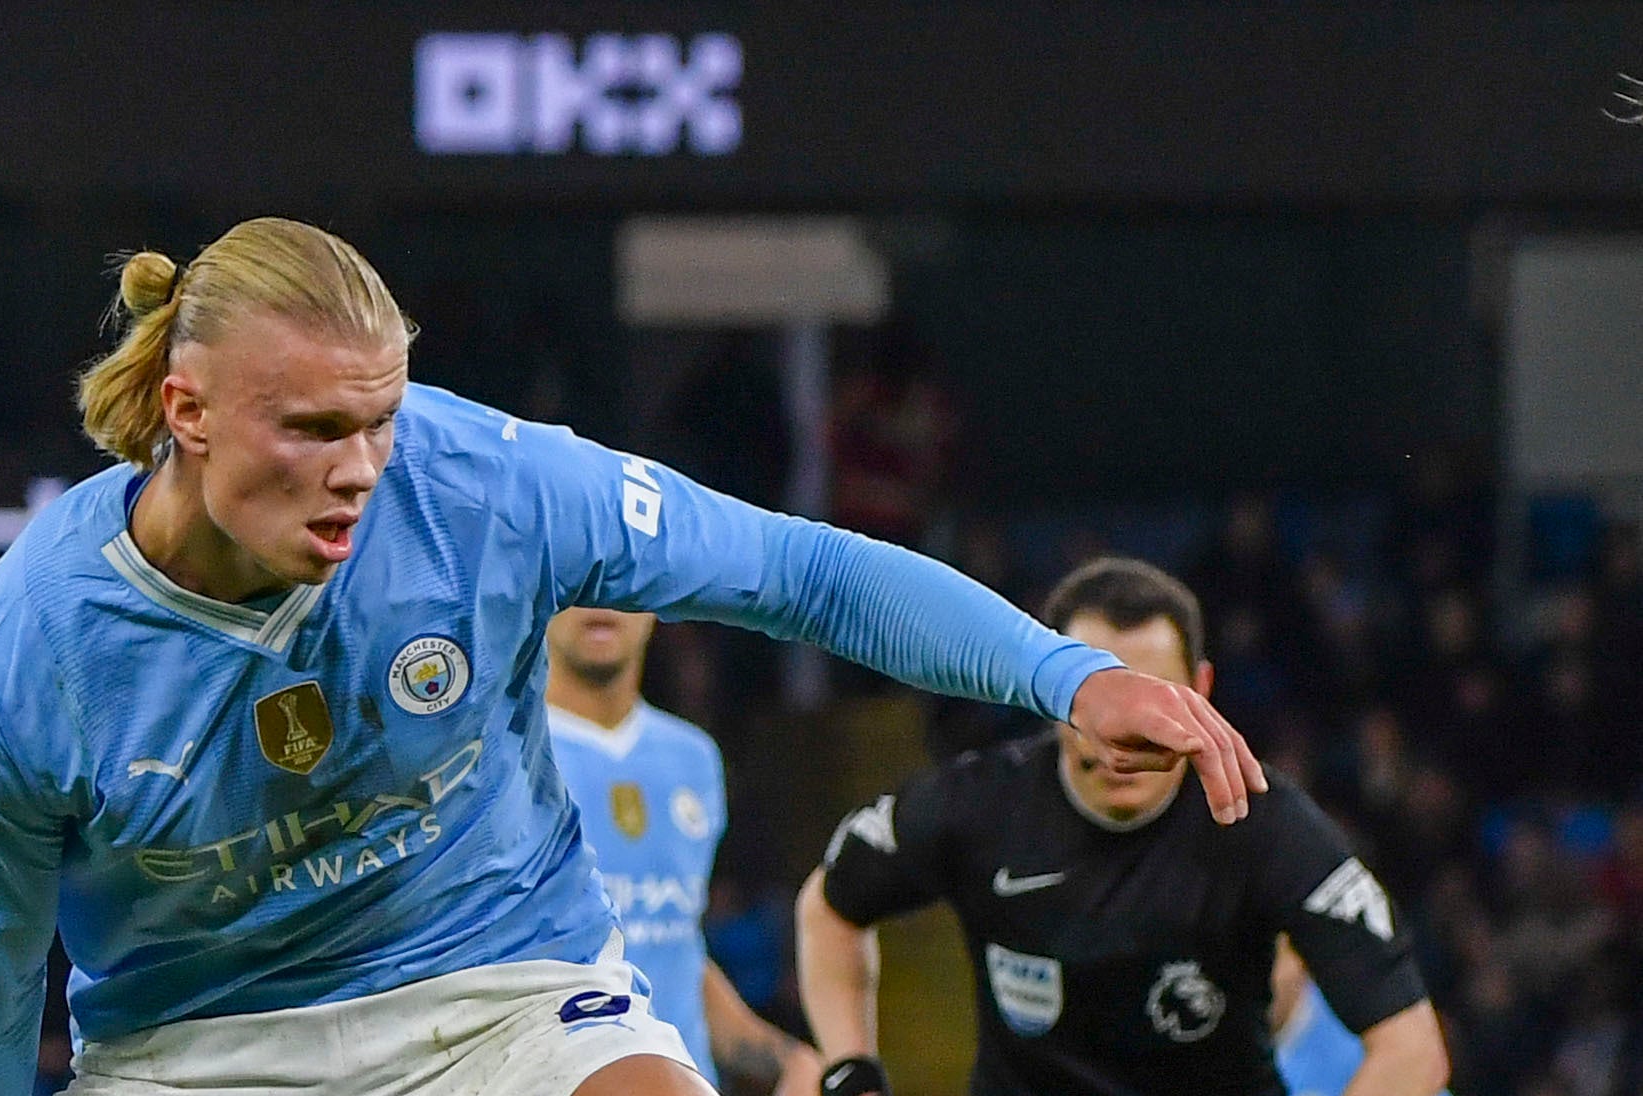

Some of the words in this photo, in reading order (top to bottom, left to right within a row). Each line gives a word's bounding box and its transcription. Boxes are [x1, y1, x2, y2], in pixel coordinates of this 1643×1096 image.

[414, 32, 744, 156] OKX
[621, 455, 662, 538] OK
[392, 641, 456, 679] MANCHESTER
[427, 697, 450, 712] CITY
[283, 737, 317, 756] FIFA
[135, 739, 483, 881] ETIHAD
[211, 813, 442, 903] AIRWAYS
